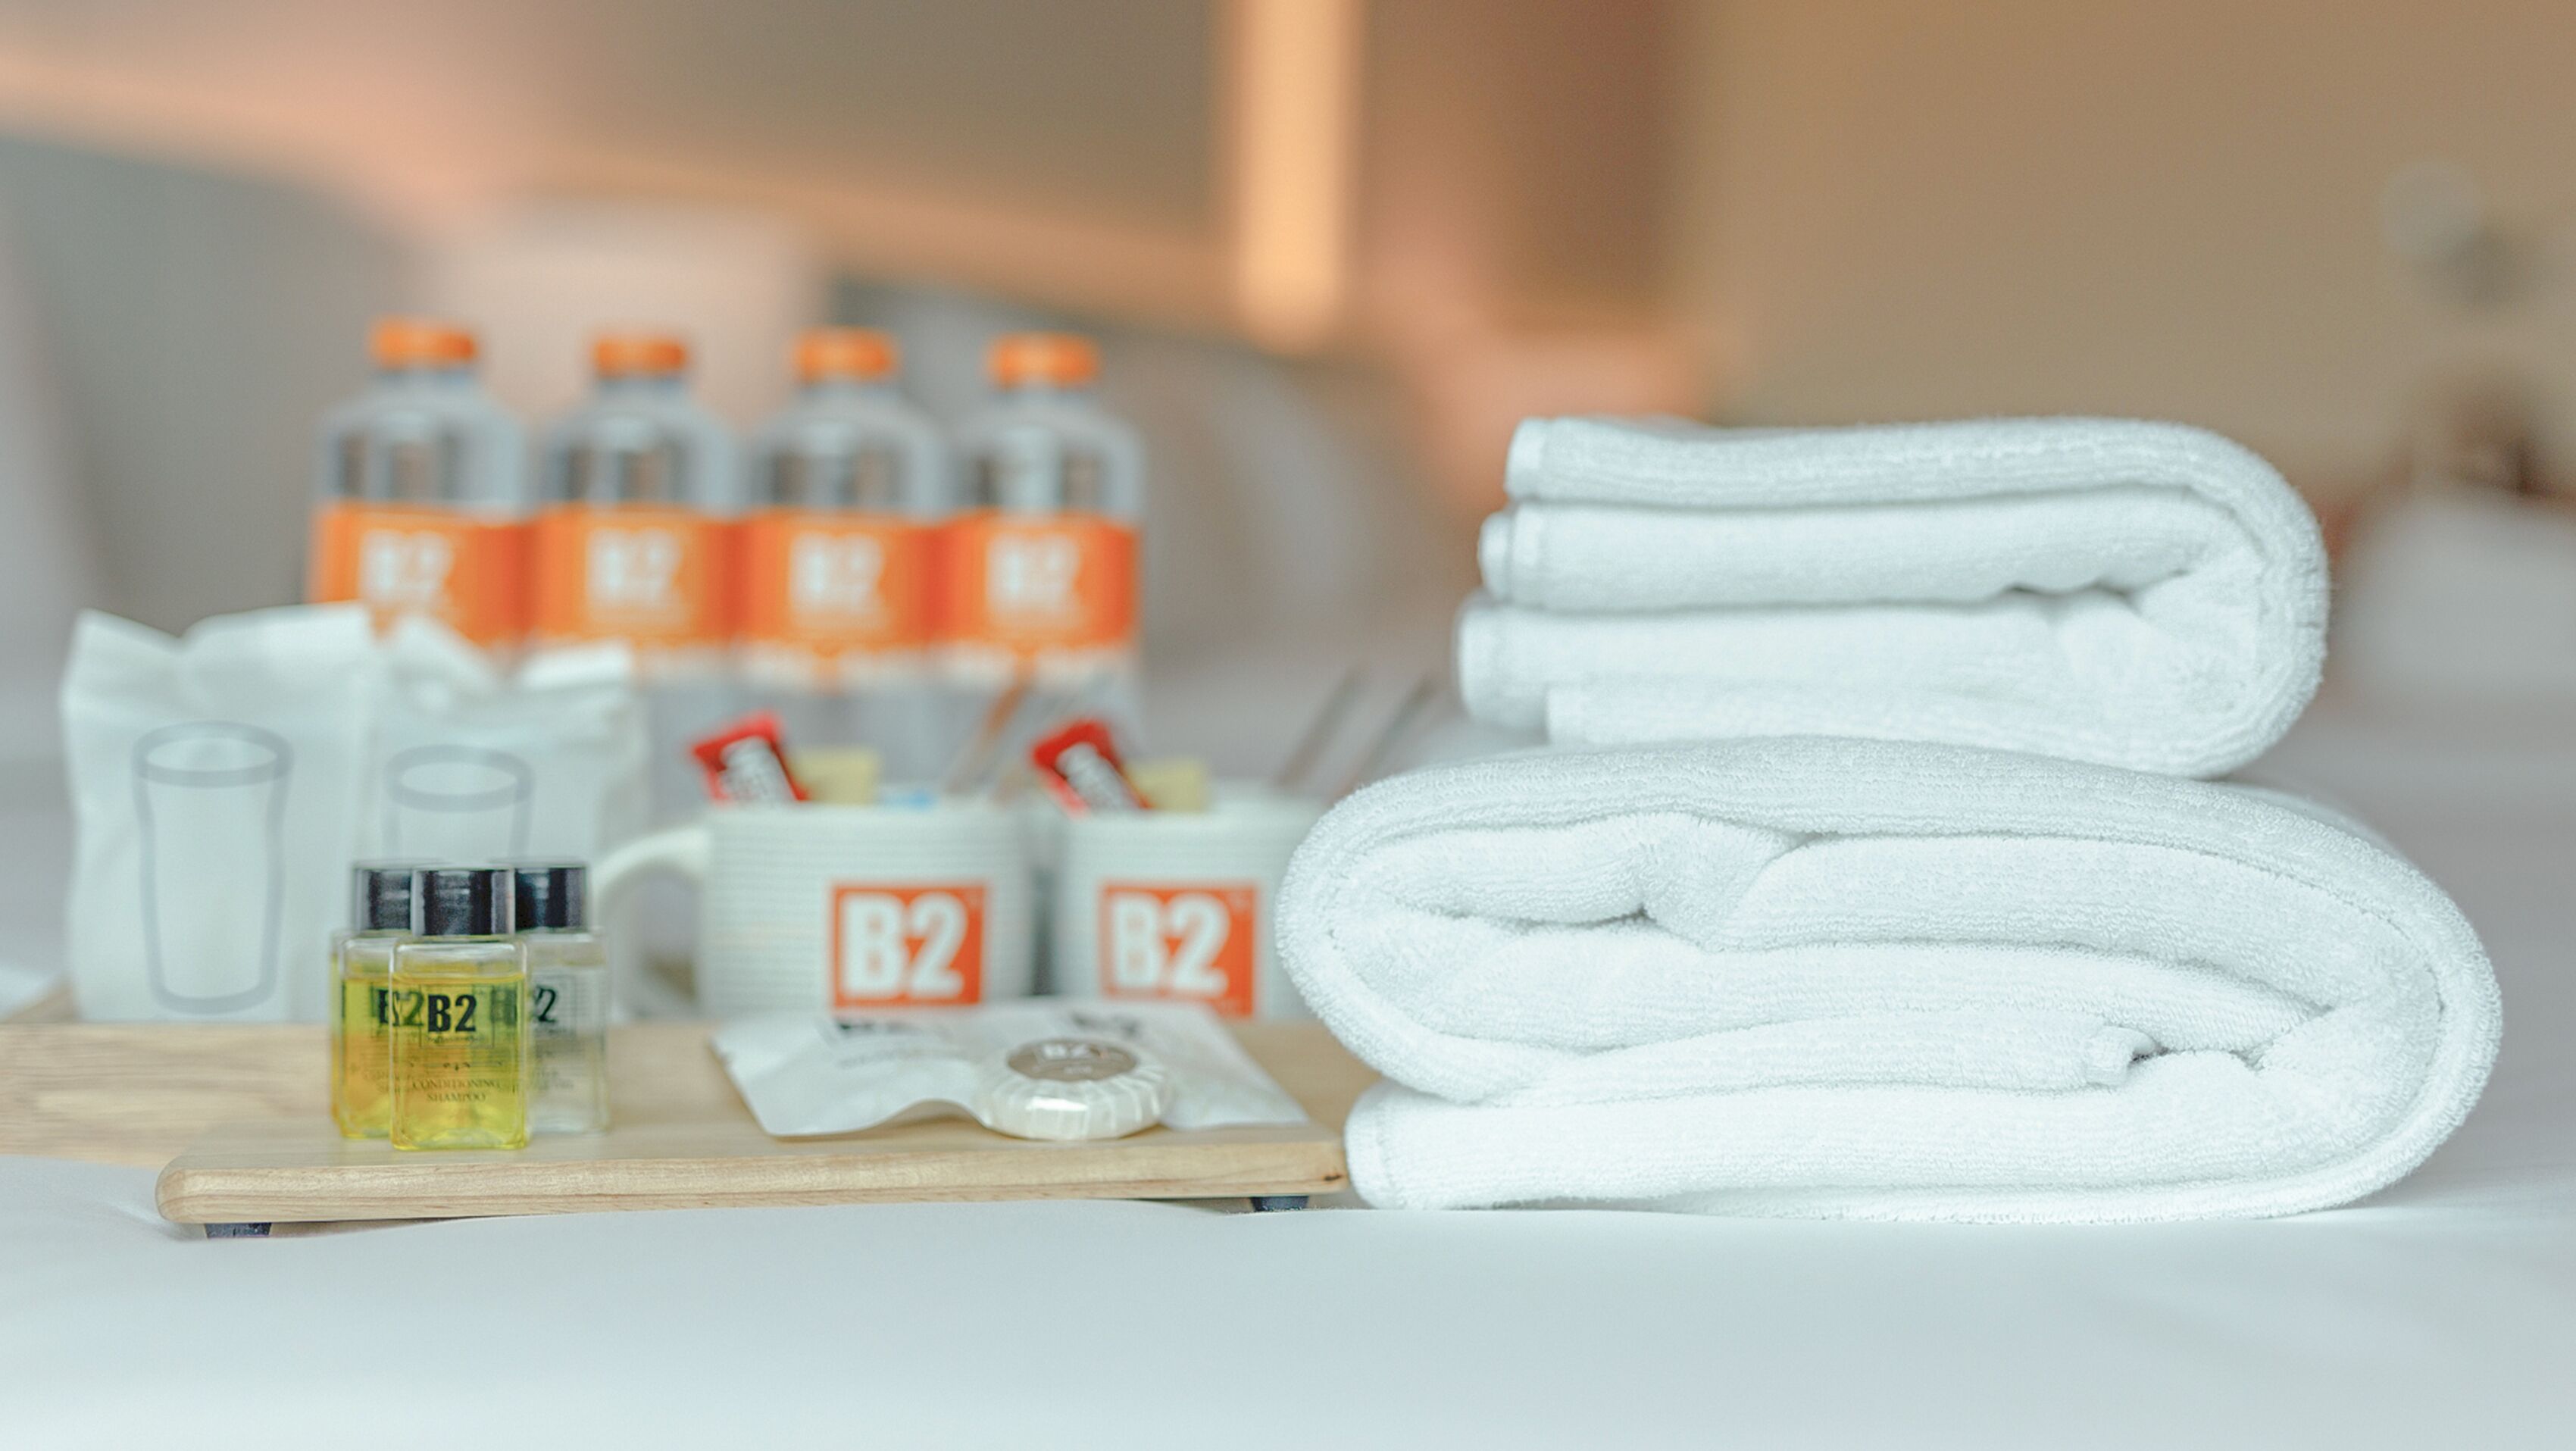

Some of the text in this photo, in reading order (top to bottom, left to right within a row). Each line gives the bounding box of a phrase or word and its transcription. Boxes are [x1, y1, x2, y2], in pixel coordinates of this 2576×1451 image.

[839, 890, 968, 999] B2
[1114, 894, 1229, 991] B2
[427, 994, 477, 1032] B2
